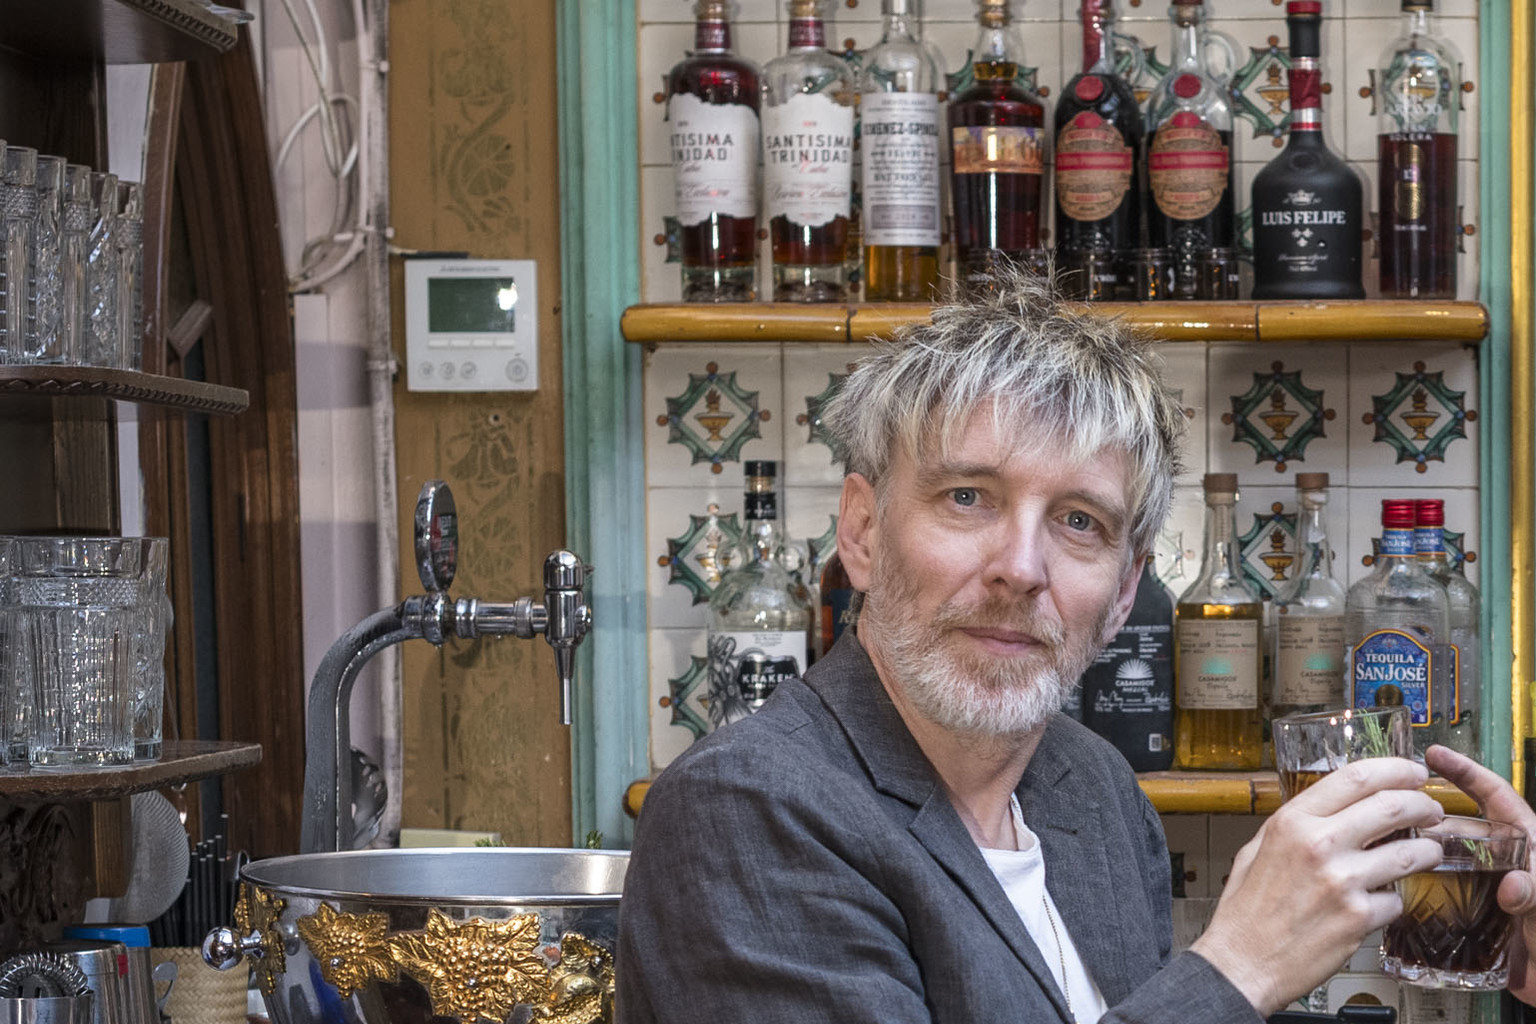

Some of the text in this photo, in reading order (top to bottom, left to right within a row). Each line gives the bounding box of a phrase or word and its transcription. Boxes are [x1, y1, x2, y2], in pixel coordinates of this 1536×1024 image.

[1262, 210, 1346, 226] LUIS FELIPE
[1365, 653, 1414, 664] TEQUILA
